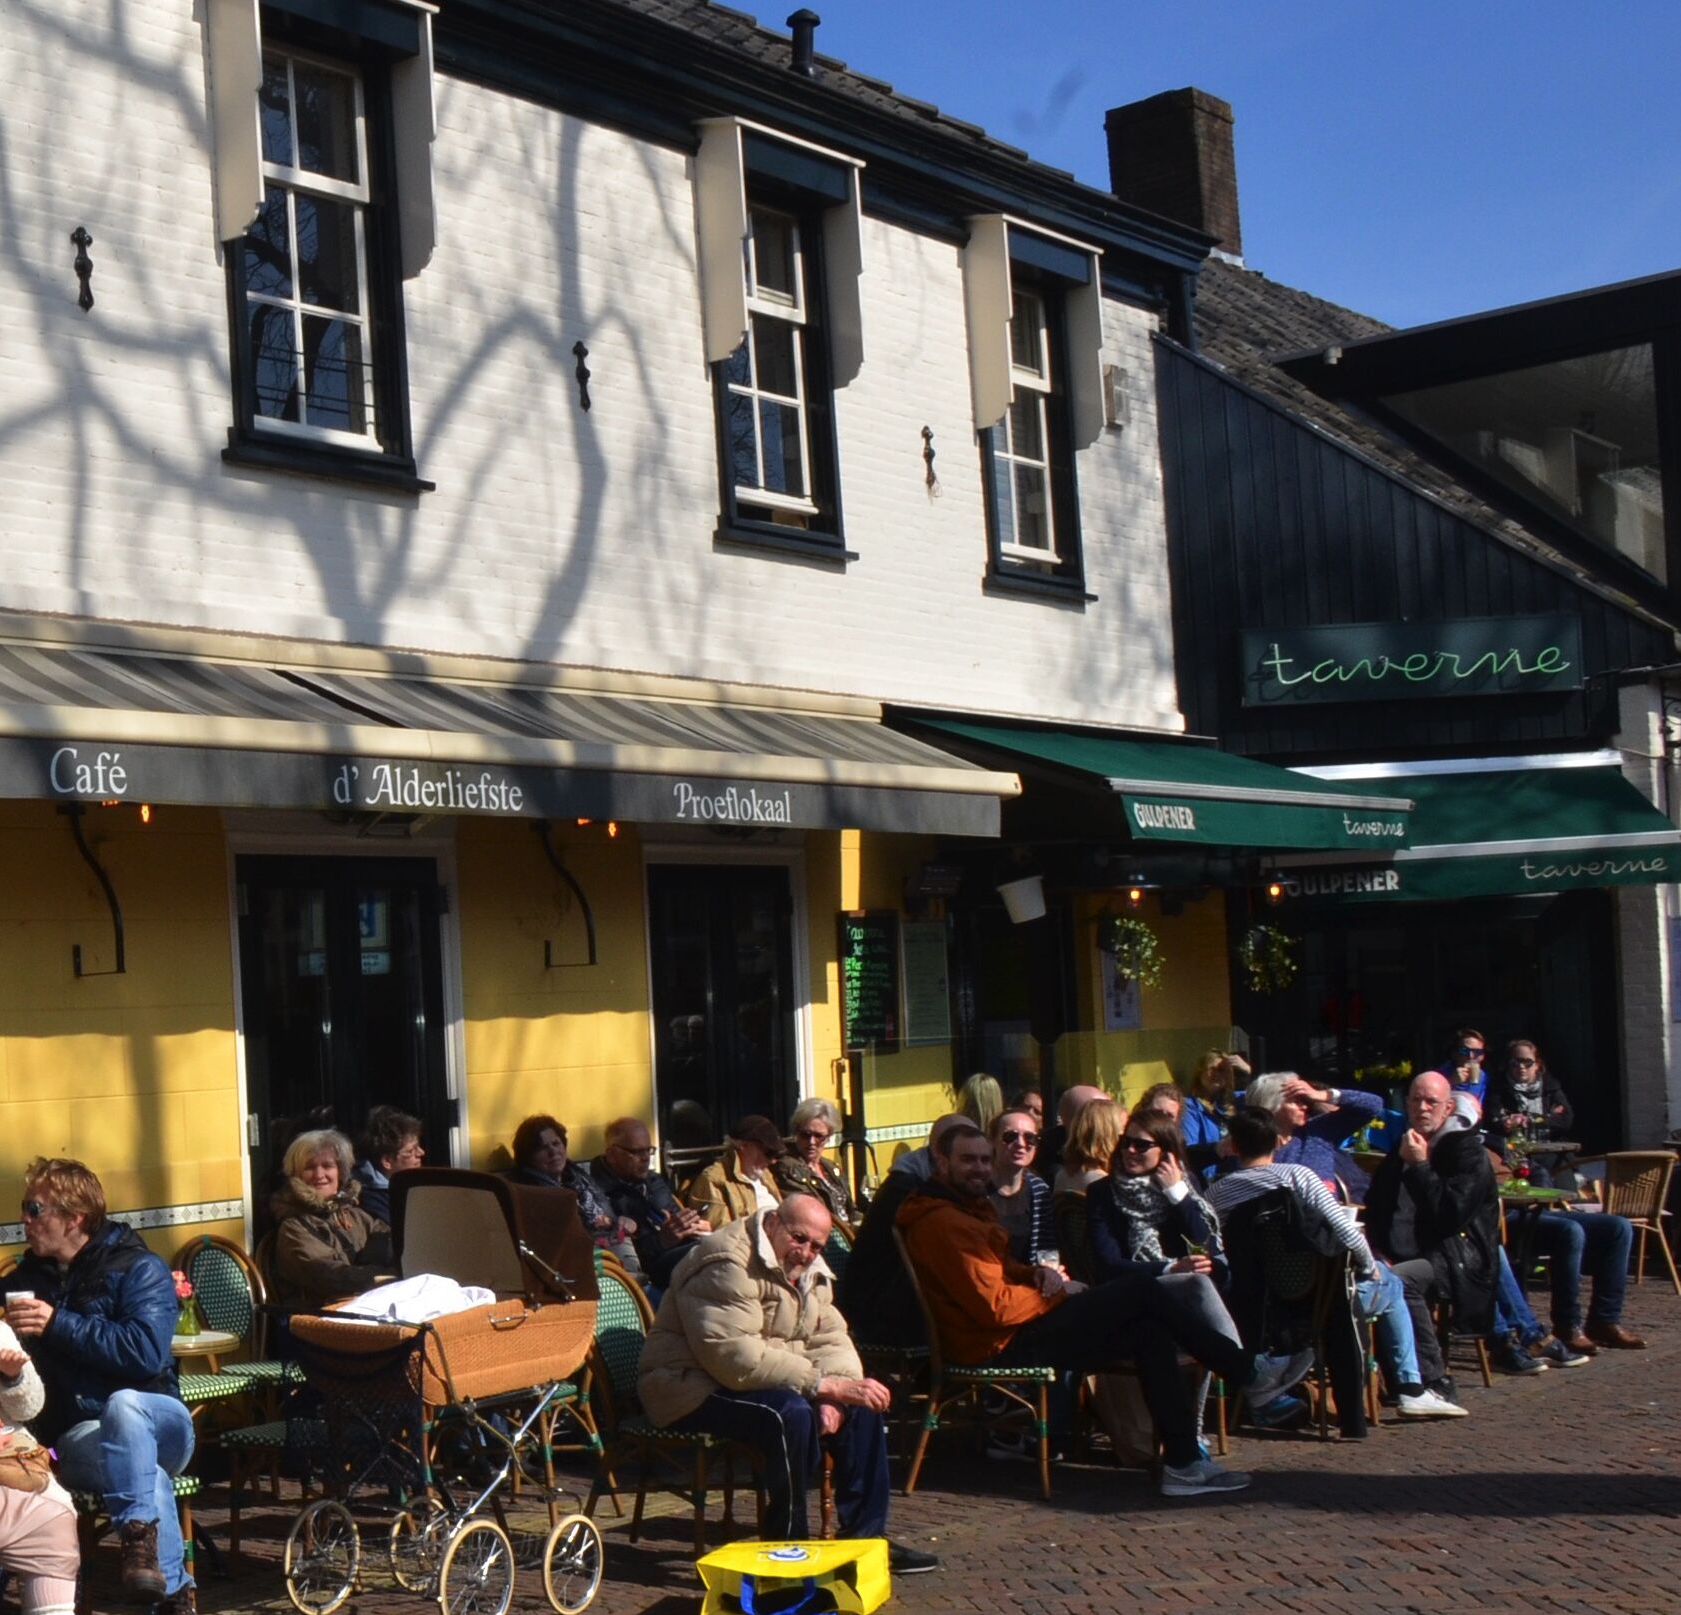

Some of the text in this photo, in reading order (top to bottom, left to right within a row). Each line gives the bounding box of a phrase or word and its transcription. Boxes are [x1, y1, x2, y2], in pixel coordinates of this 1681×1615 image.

[1263, 643, 1571, 685] taverne
[50, 747, 128, 795] Café
[365, 763, 524, 812] Alderliefste
[673, 782, 793, 824] Proeflokaal
[1133, 802, 1196, 831] GULPENER
[1343, 812, 1405, 838] taverne
[1286, 869, 1401, 897] GULPENER
[1521, 851, 1669, 880] taverne
